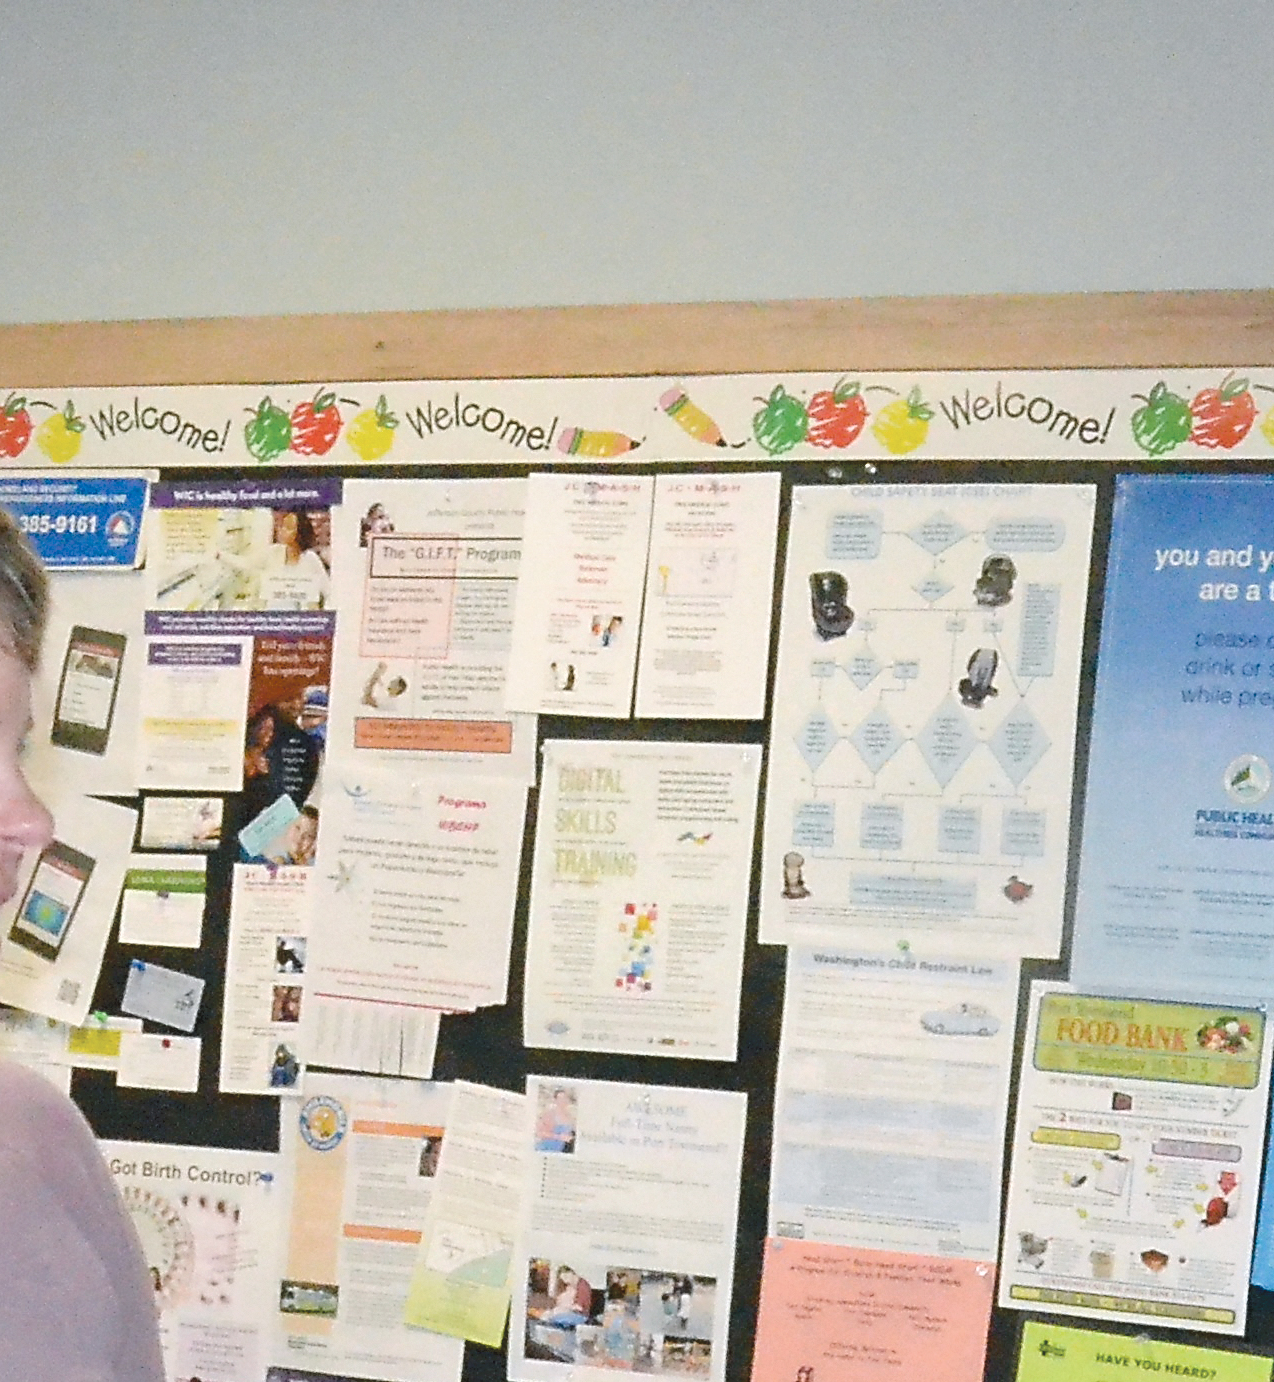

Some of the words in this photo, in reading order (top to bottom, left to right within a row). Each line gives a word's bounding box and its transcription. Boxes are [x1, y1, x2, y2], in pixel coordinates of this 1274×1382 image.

[90, 397, 231, 453] Welcome!
[407, 392, 560, 451] Welcome!
[939, 384, 1117, 445] Welcome!
[383, 547, 405, 560] The
[466, 547, 522, 563] Program
[1155, 546, 1199, 570] you
[1206, 544, 1252, 568] and
[1199, 582, 1238, 601] are
[1246, 585, 1261, 601] a
[1195, 631, 1259, 652] please
[1185, 659, 1235, 677] drink
[1242, 662, 1261, 679] or
[1181, 687, 1232, 706] while
[558, 767, 626, 794] DIGITAL
[438, 795, 487, 810] Programa
[554, 808, 618, 834] SKILLS
[1195, 809, 1240, 826] PUBLIC
[555, 848, 637, 878] TRAINING
[813, 952, 885, 971] Washington's
[919, 961, 968, 975] Restraint
[1056, 1017, 1119, 1047] FOOD
[1125, 1023, 1188, 1052] BANK
[110, 1158, 138, 1176] Got
[142, 1160, 182, 1179] Birth
[187, 1163, 262, 1186] Control?
[1095, 1352, 1130, 1367] HAVE
[1135, 1358, 1161, 1372] YOU
[1166, 1364, 1217, 1380] HEARD?
